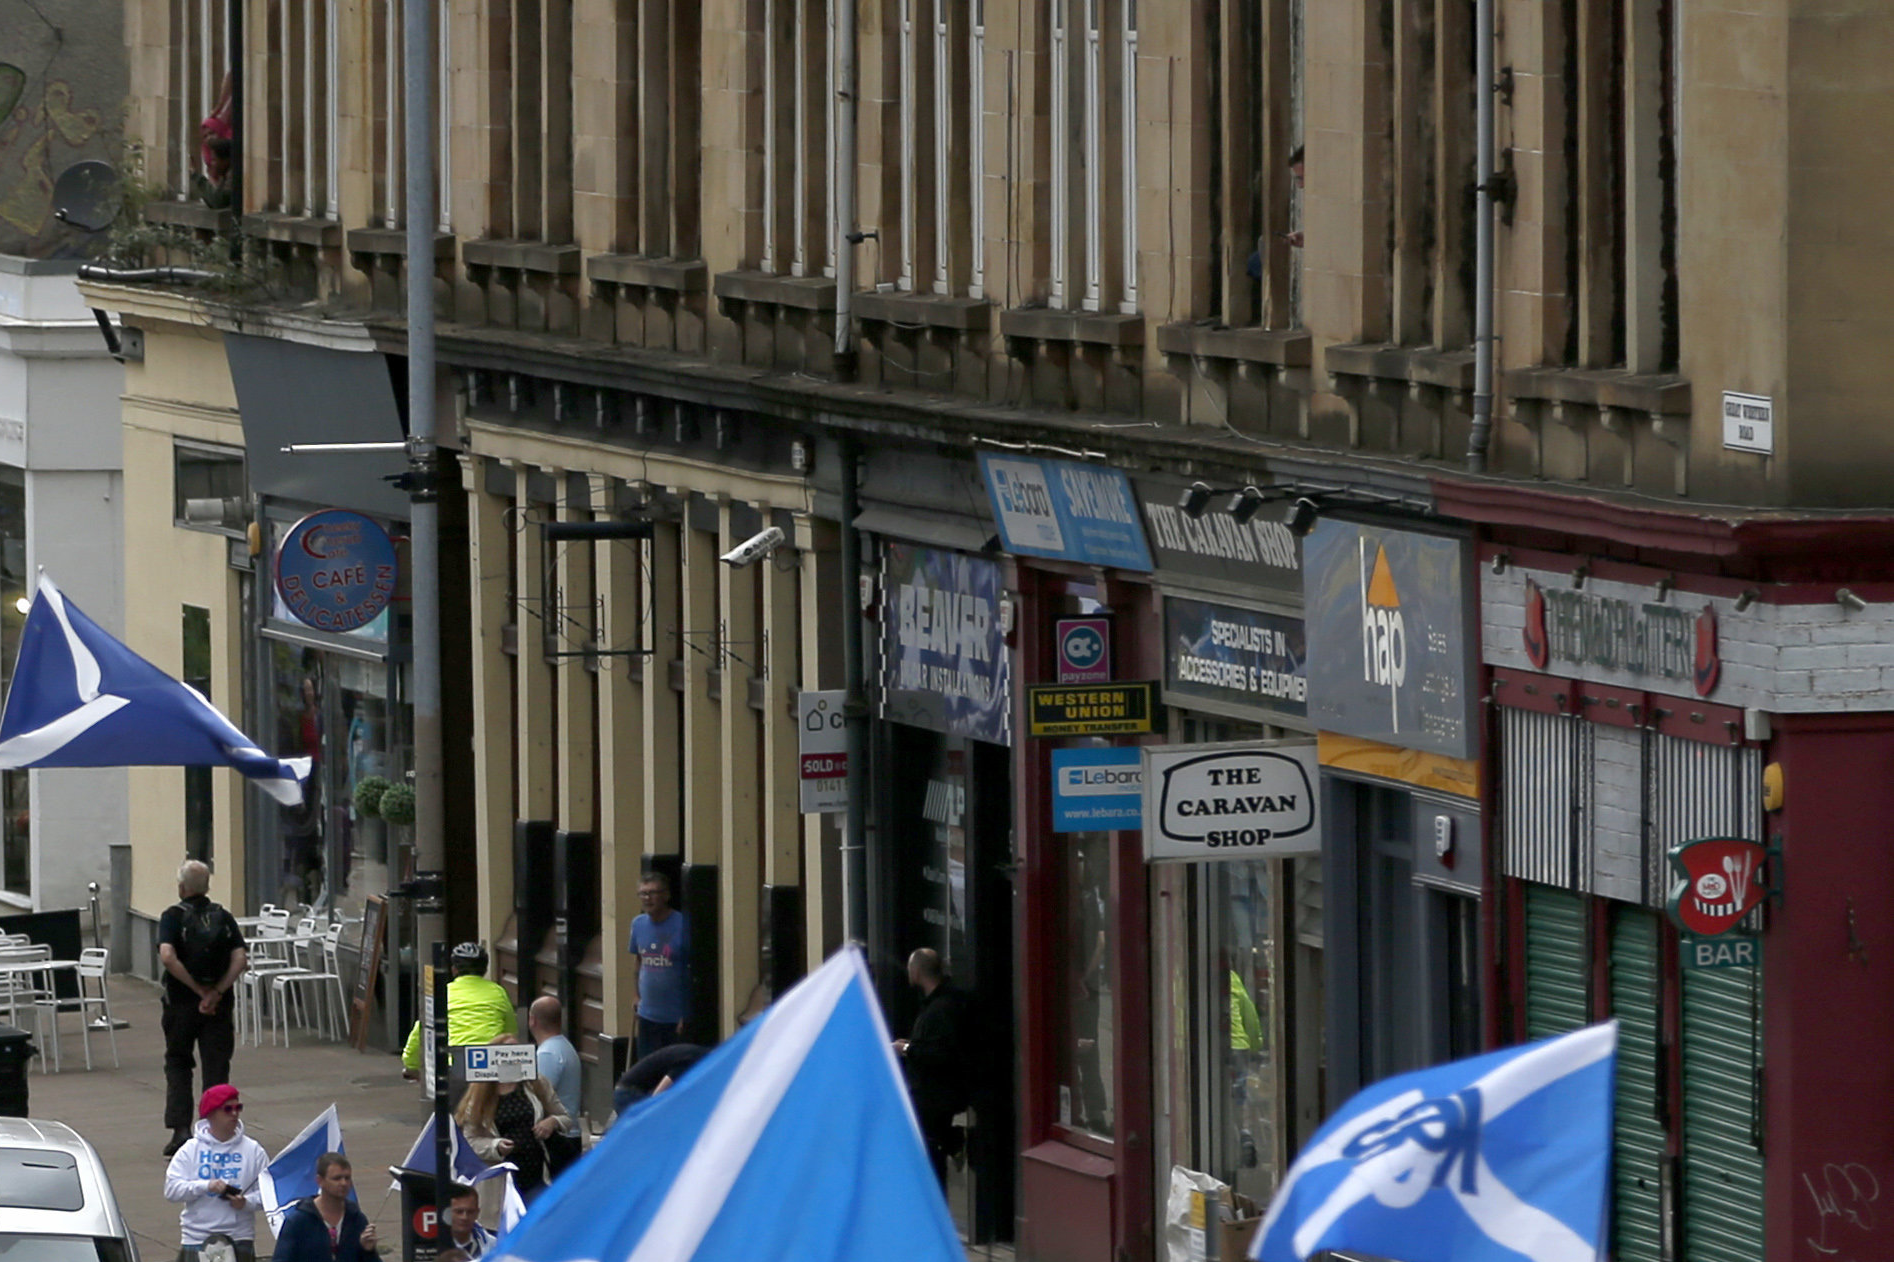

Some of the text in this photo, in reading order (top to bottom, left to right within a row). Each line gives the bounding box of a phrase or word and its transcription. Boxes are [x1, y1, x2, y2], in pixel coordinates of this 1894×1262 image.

[1146, 502, 1186, 552] THE
[1180, 509, 1260, 563] CARAVAN
[284, 565, 395, 628] DELICATESSEN
[899, 583, 991, 662] BEAVER
[1210, 619, 1286, 657] SPECIALISTS IN
[1359, 536, 1406, 735] hap
[1061, 671, 1107, 683] payzone
[1178, 655, 1247, 690] ACCESSORIES
[1249, 672, 1257, 691] &
[1037, 691, 1125, 706] WESTERN
[1065, 705, 1125, 718] UNION
[1042, 721, 1138, 733] MONEY TRANSFER
[805, 756, 834, 772] SOLD
[1207, 767, 1262, 786] THE
[1177, 795, 1297, 817] CARAVAN
[1207, 828, 1271, 847] SHOP
[1695, 941, 1755, 967] BAR
[199, 1150, 242, 1167] Hope
[198, 1164, 242, 1180] Over
